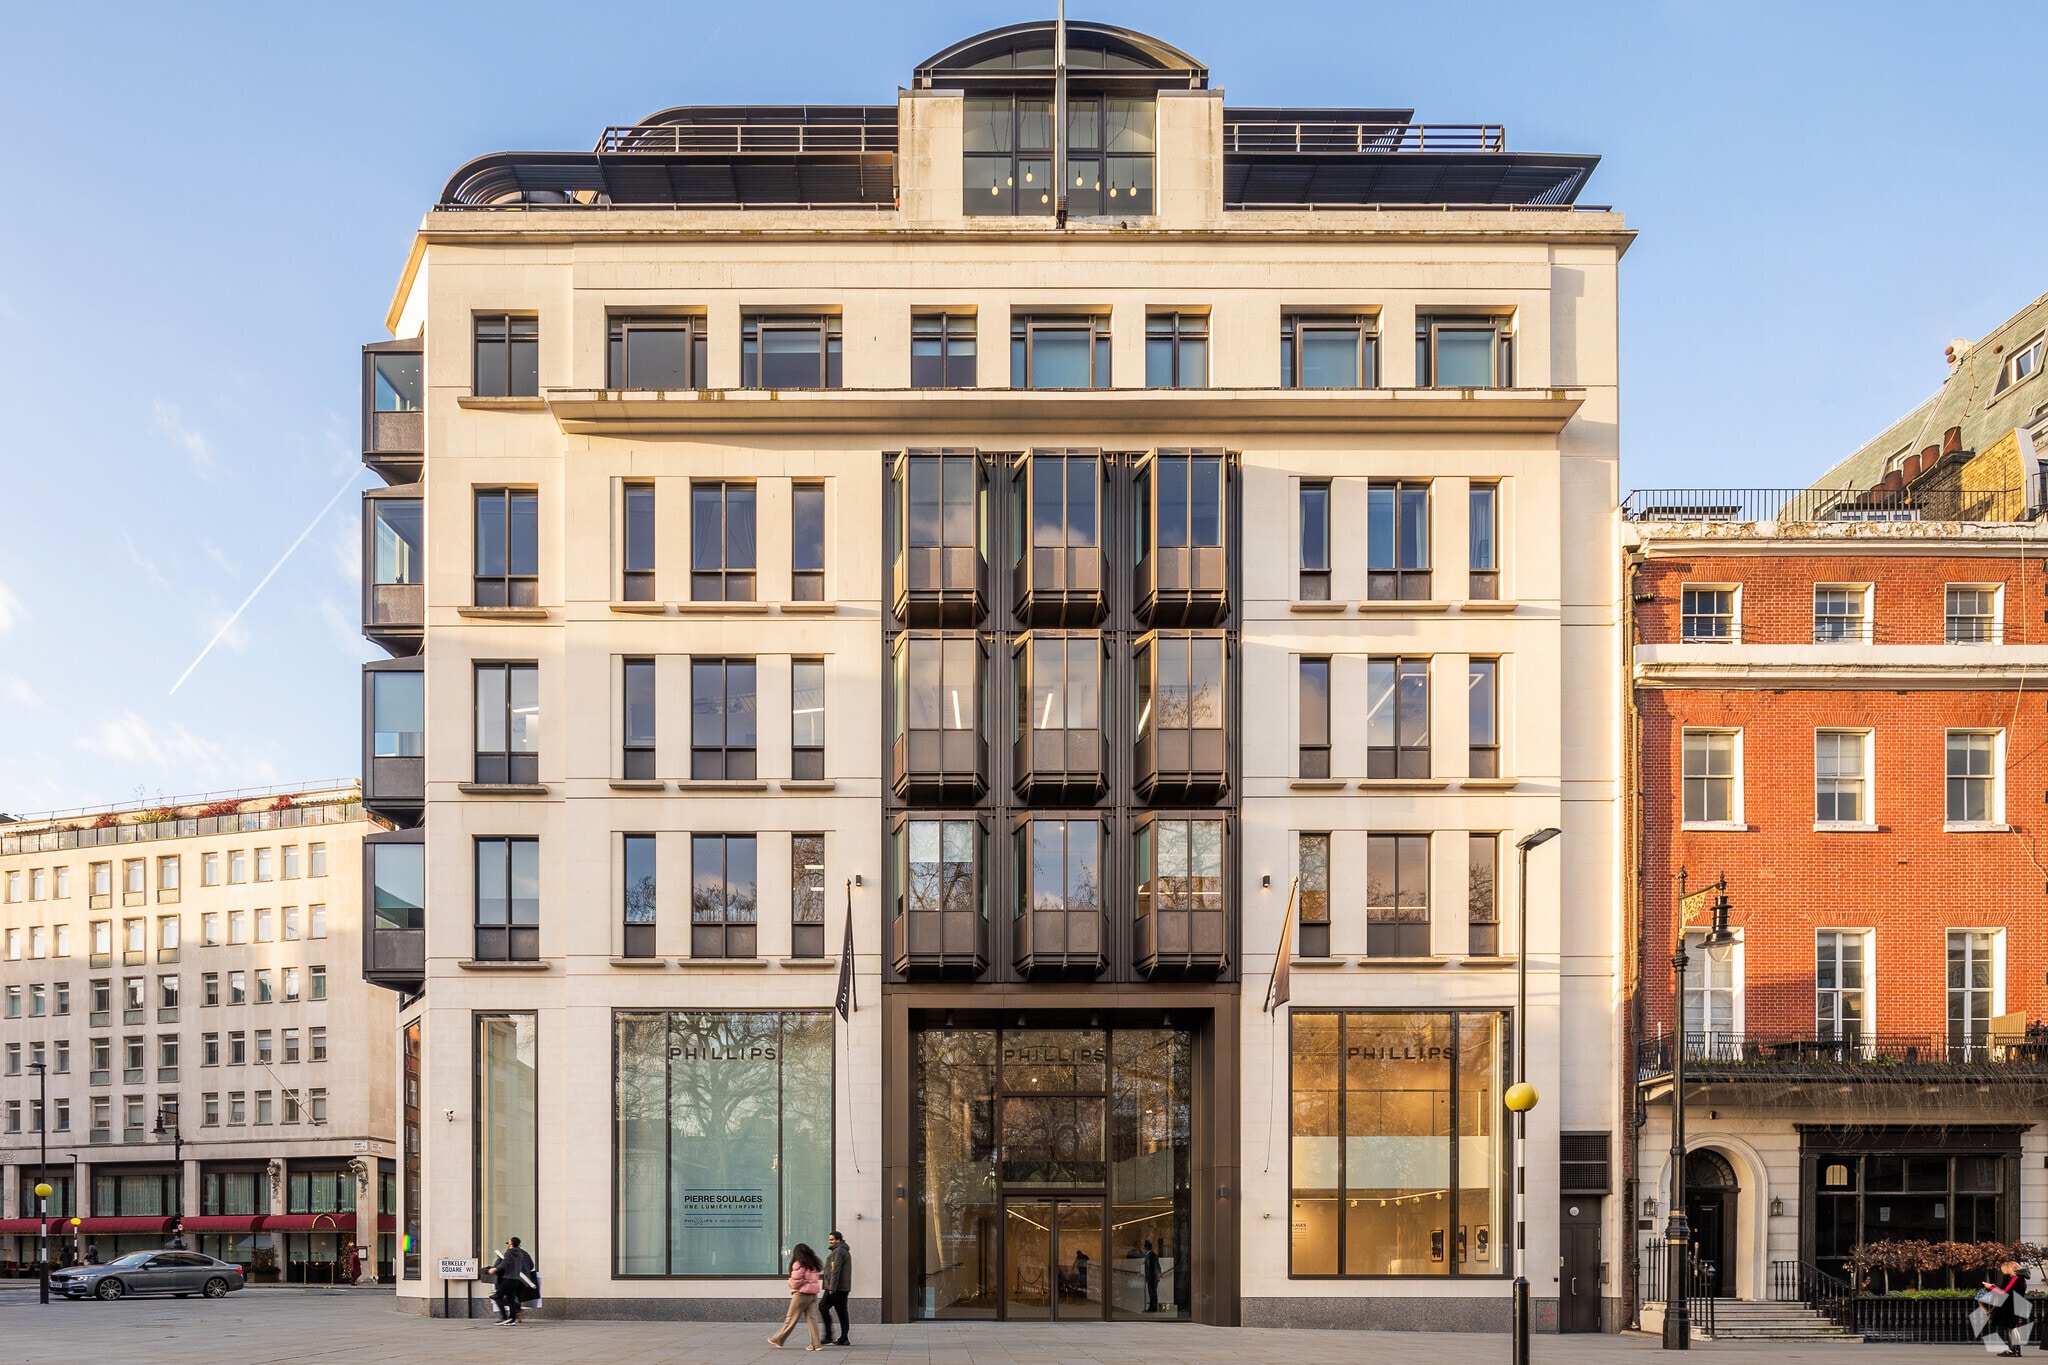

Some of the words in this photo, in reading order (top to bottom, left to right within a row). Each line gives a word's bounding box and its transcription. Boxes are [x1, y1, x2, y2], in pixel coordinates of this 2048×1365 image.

[670, 1047, 776, 1060] PHILLIPS
[1004, 1049, 1105, 1062] PHILLIPS
[1347, 1047, 1455, 1060] PHILLIPS
